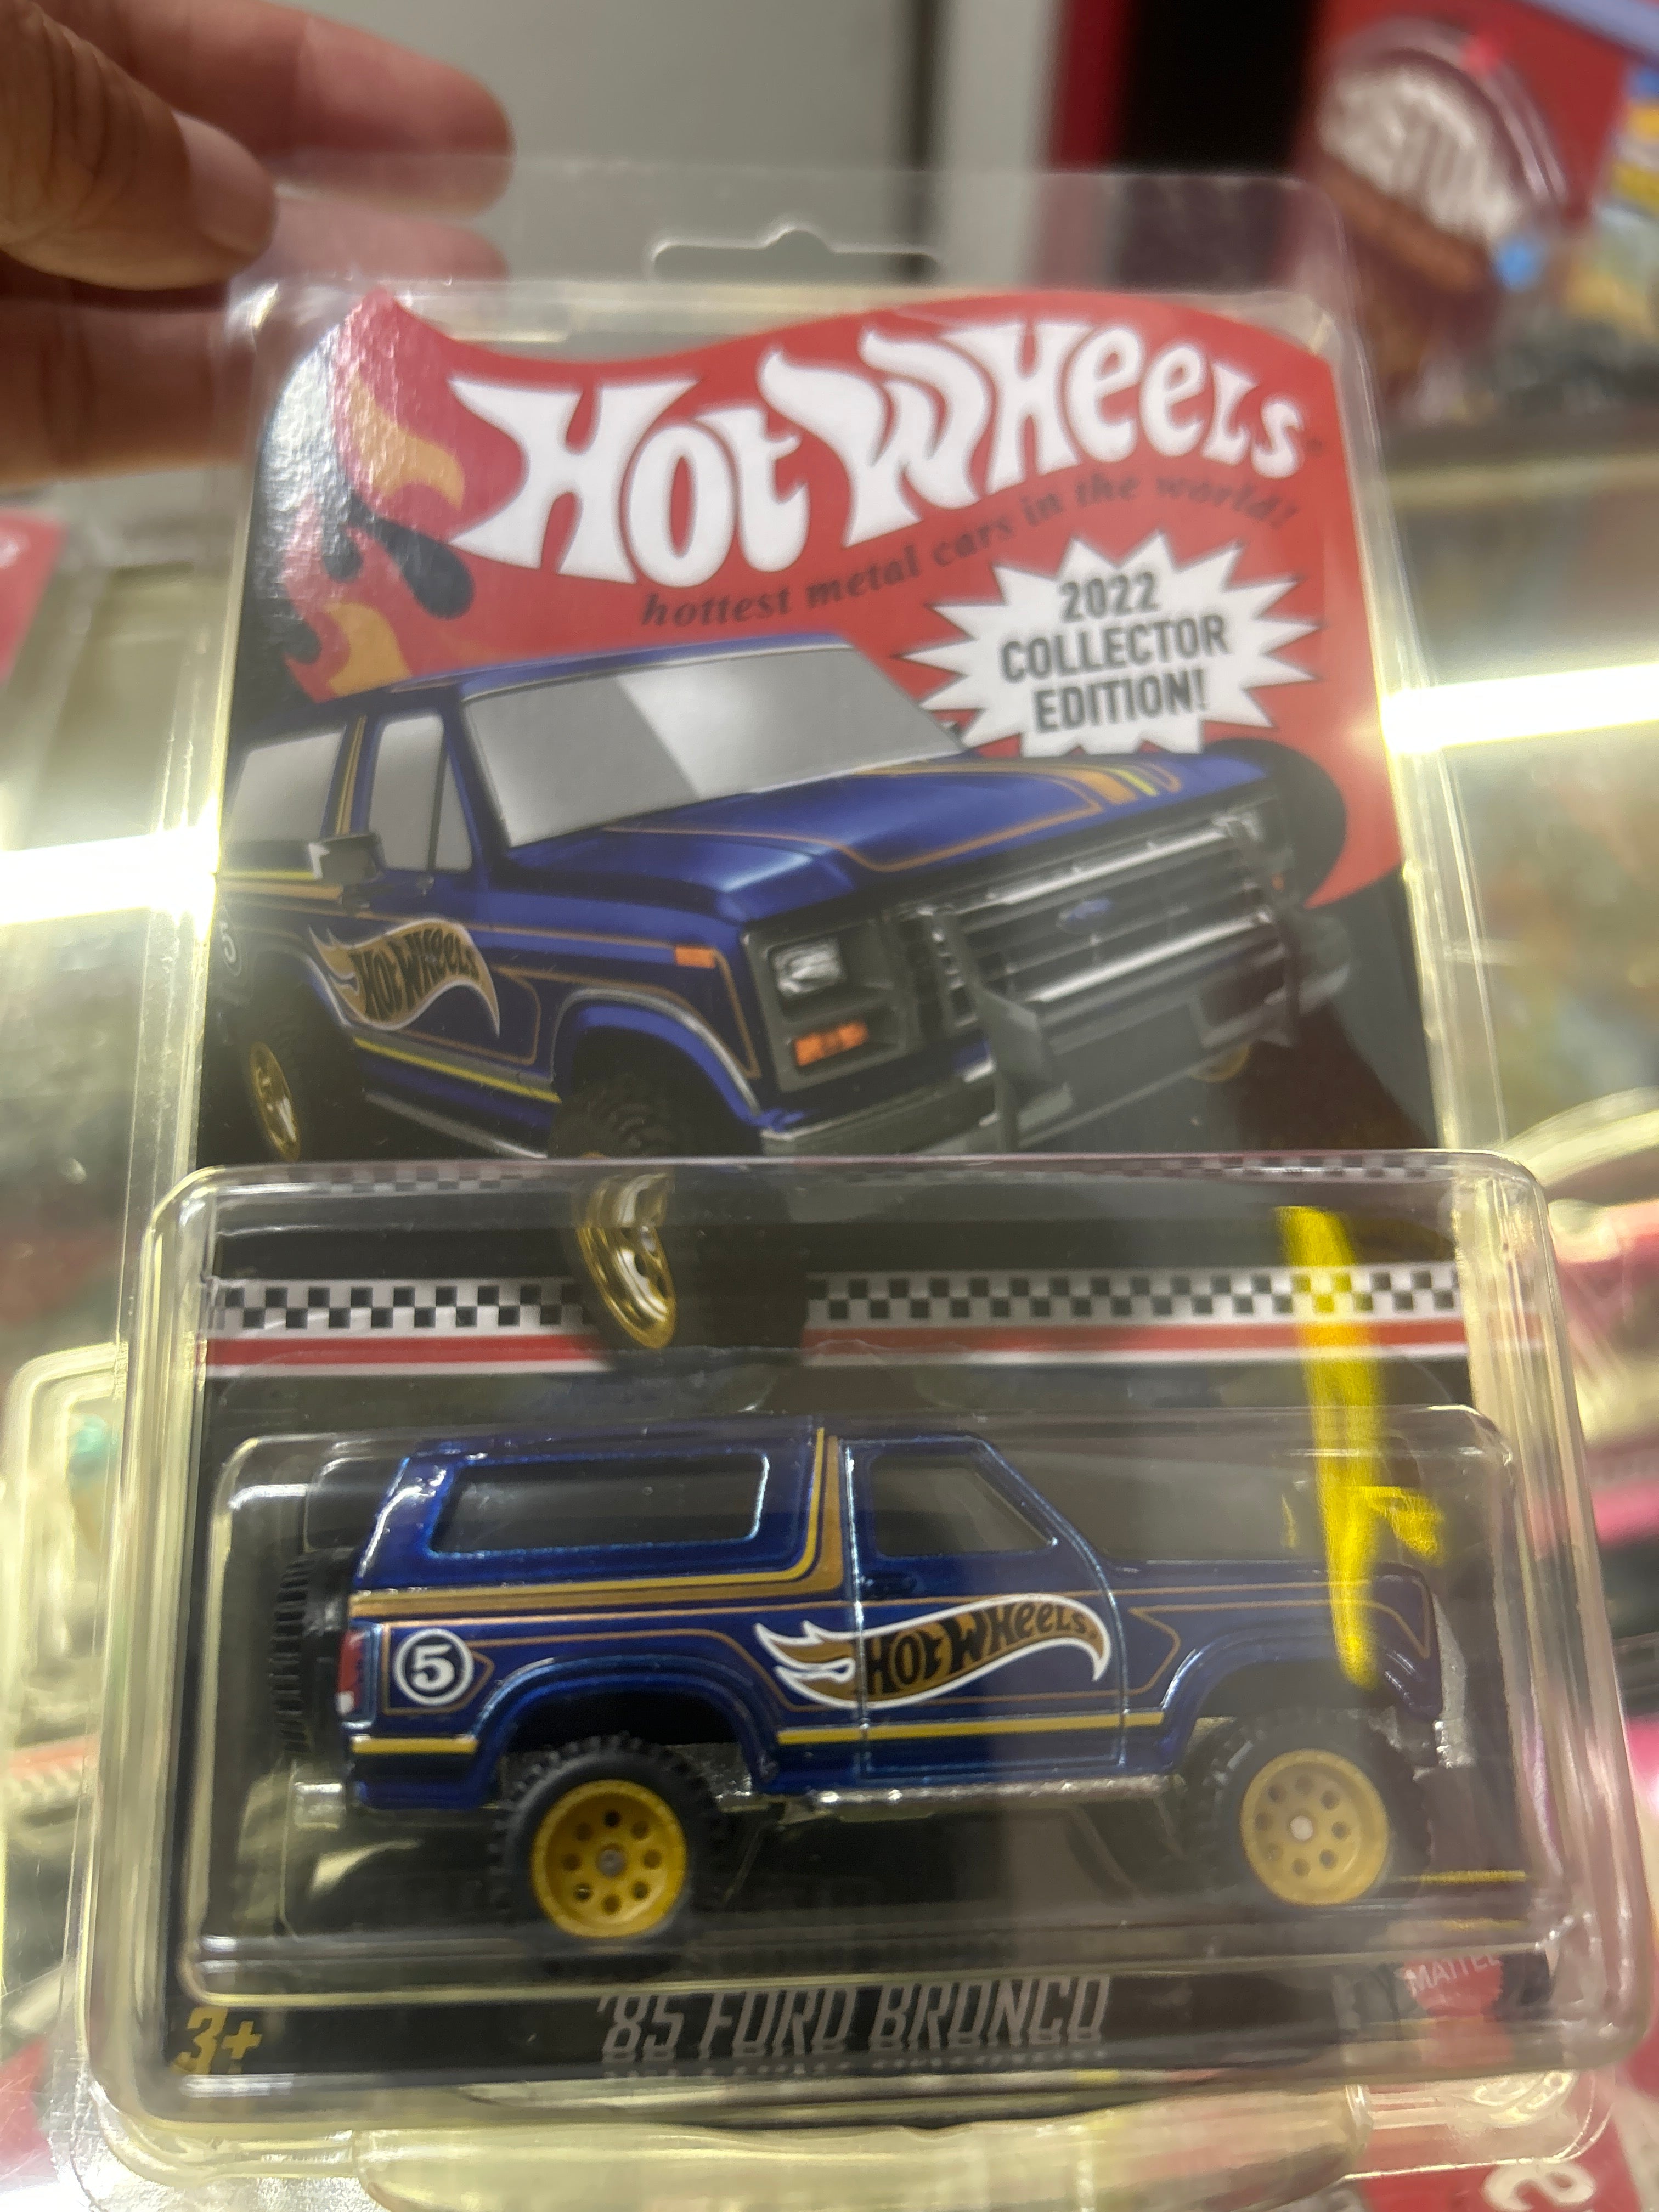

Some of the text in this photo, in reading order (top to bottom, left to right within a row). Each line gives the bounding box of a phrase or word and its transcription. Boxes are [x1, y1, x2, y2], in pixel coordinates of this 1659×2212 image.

[641, 587, 790, 628] hottest
[805, 545, 921, 608] metal
[933, 515, 1013, 565] cars
[1020, 492, 1063, 527] in
[1074, 473, 1140, 506] the
[1059, 572, 1159, 622] 2022
[1000, 615, 1230, 683] COLLECTOR
[1035, 669, 1208, 733] EDITION!
[411, 1644, 455, 1691] 5
[171, 2006, 263, 2076] 3+
[699, 1986, 858, 2059] FORD
[868, 1976, 1110, 2052] BRONCO
